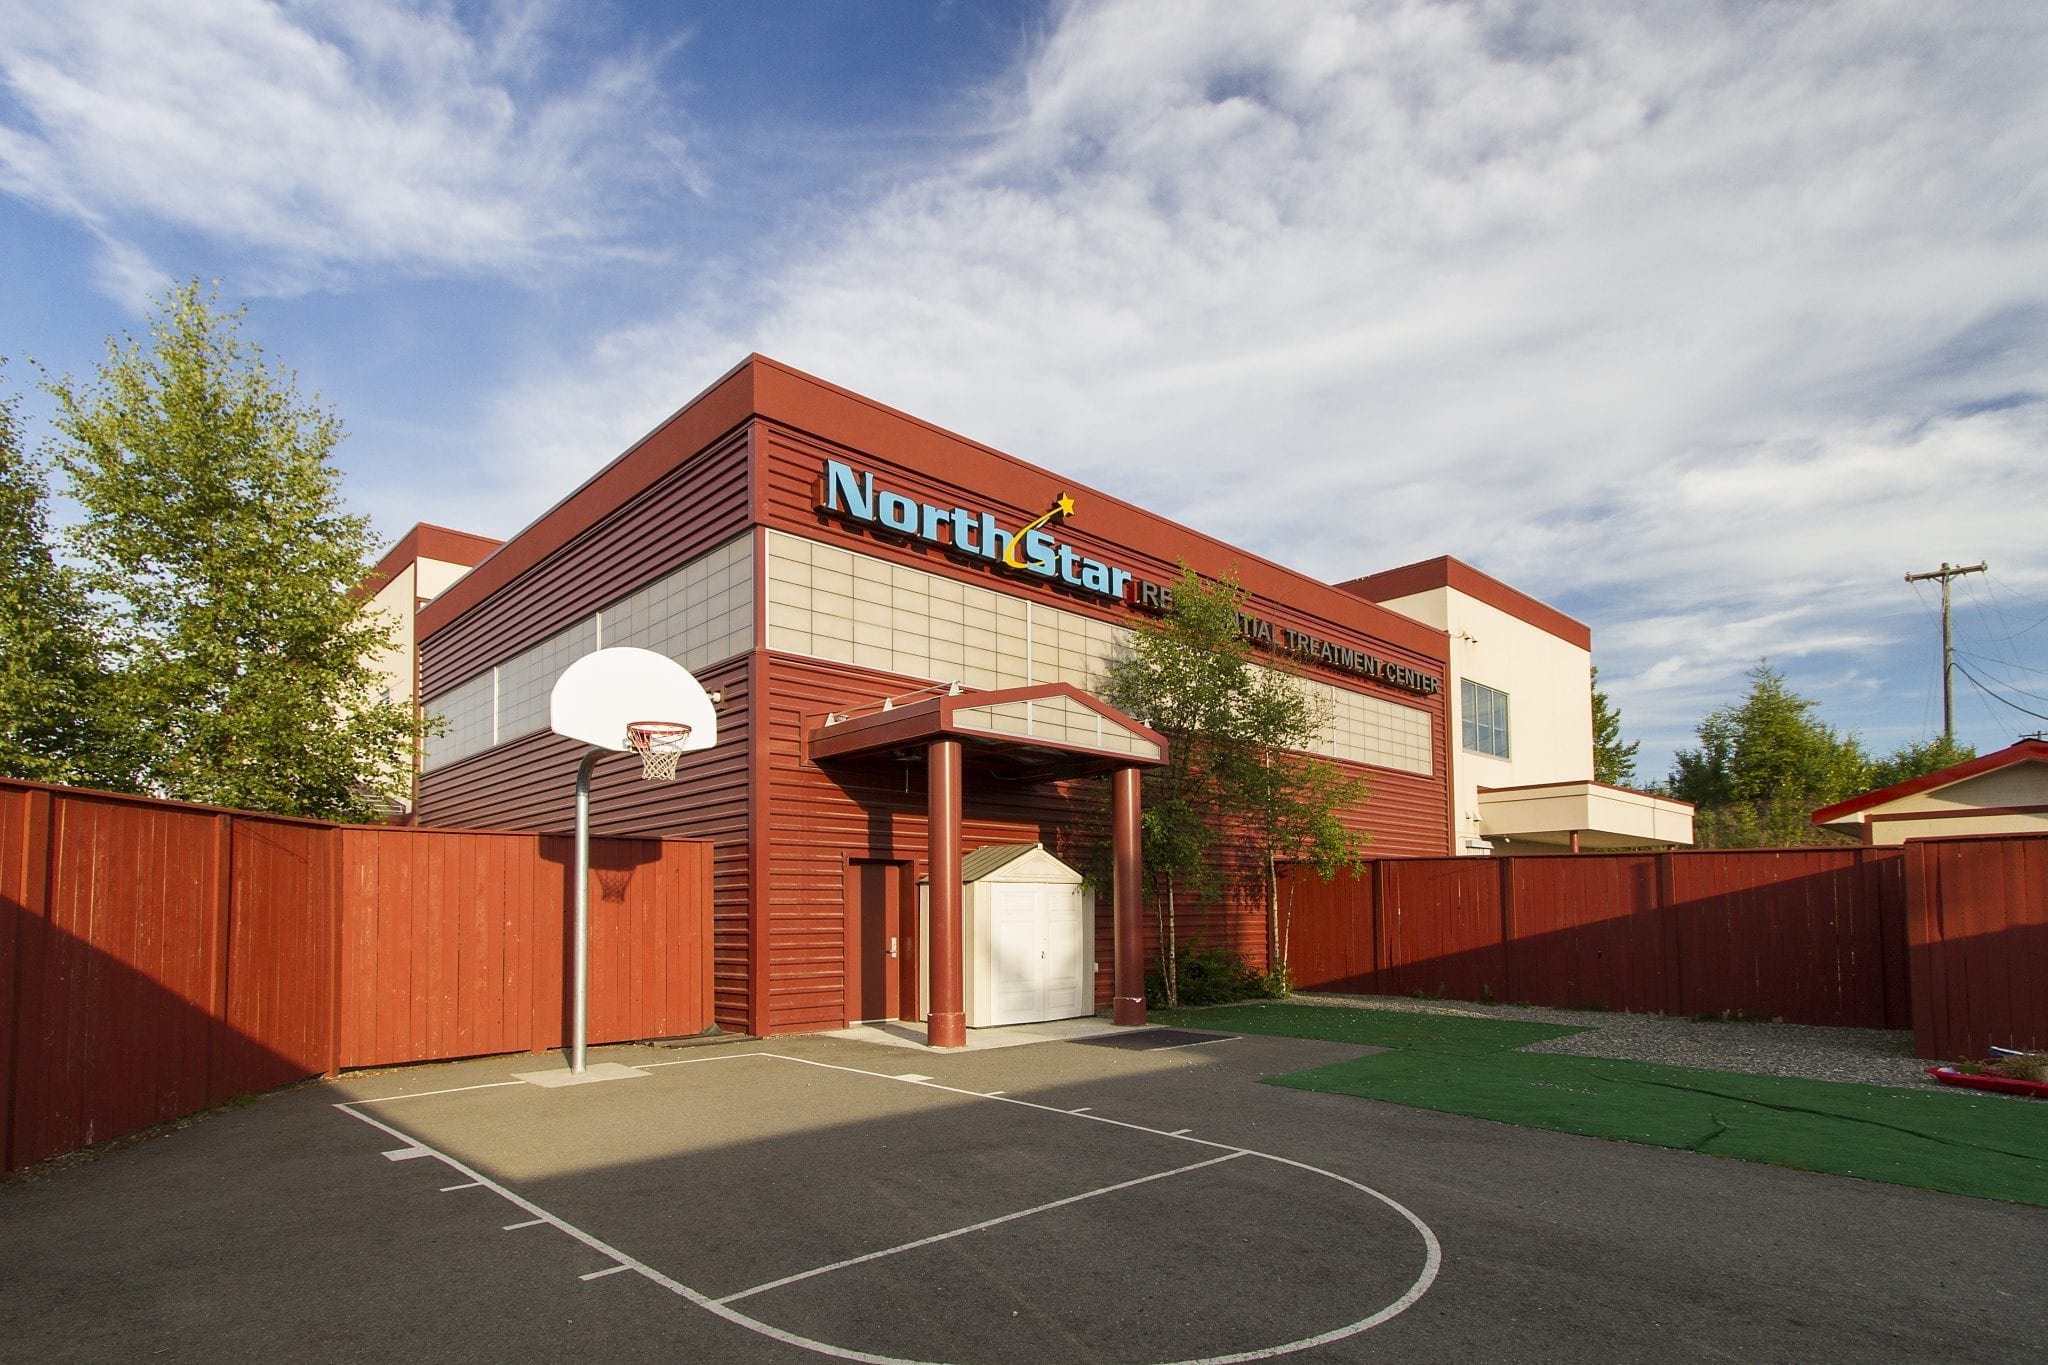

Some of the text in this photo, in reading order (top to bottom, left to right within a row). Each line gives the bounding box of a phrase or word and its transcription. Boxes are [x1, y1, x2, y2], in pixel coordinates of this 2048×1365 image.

[826, 458, 1439, 692] North Star RETIAL TREATMENT CENTER
